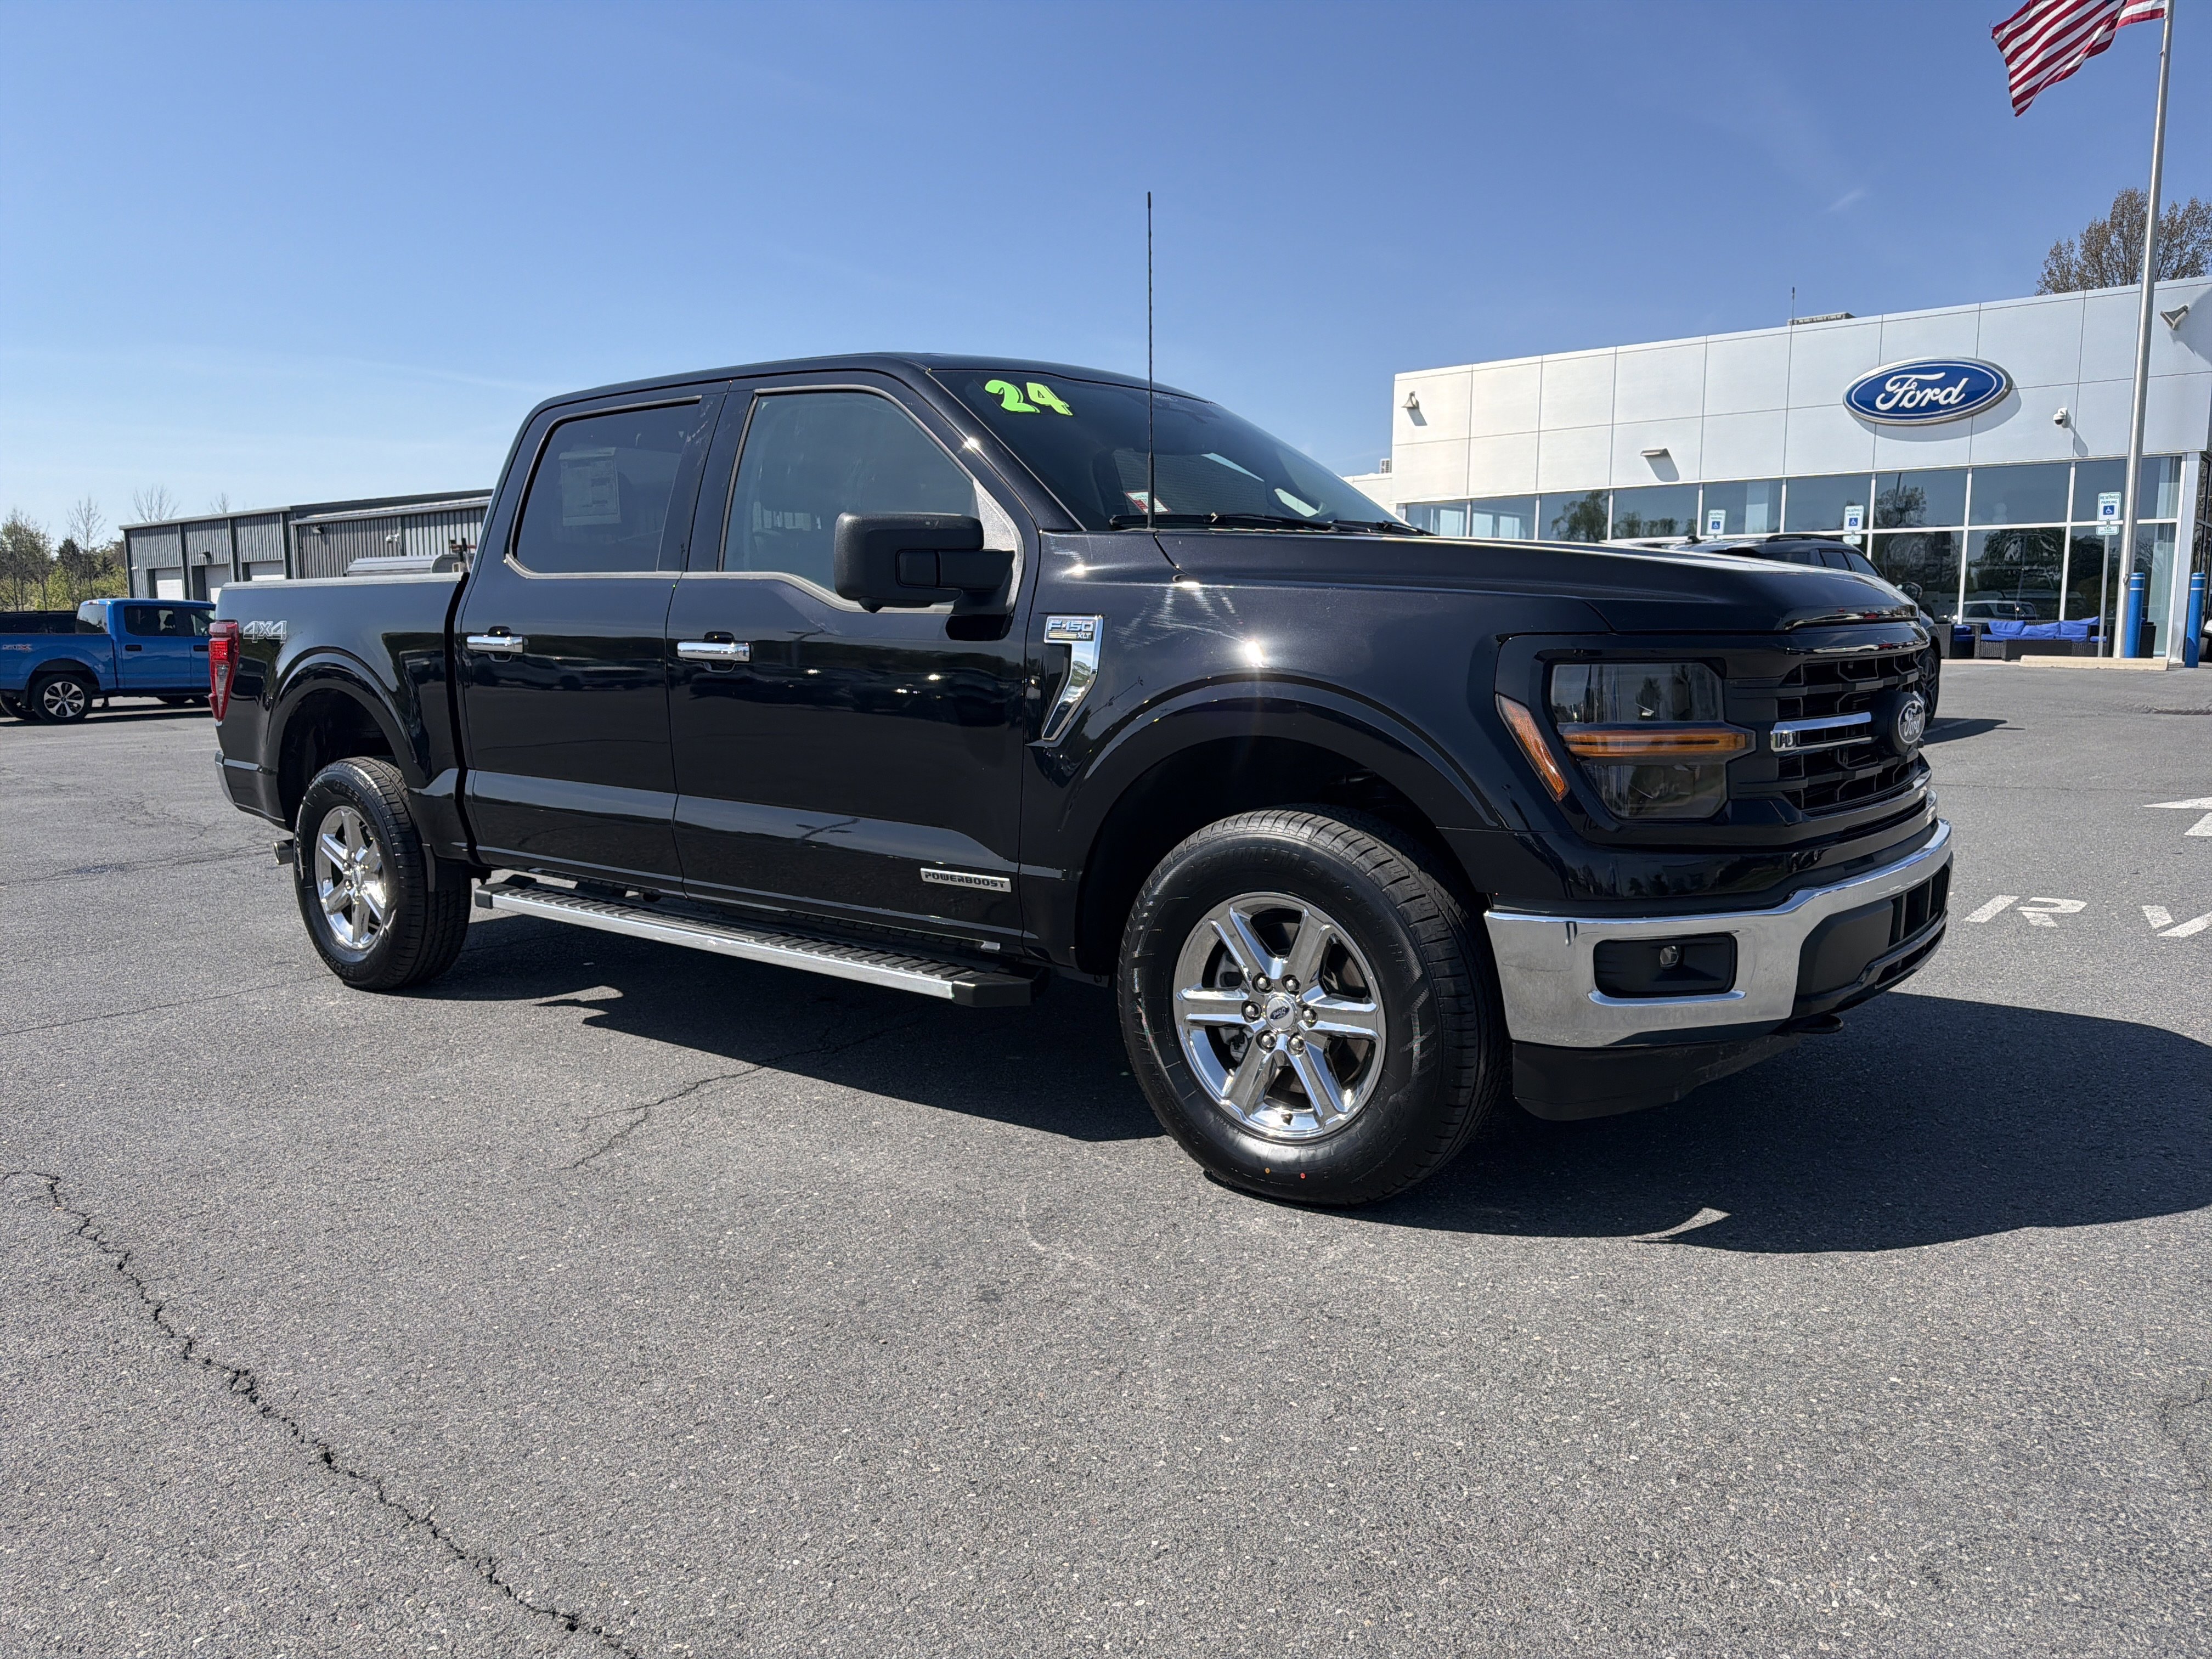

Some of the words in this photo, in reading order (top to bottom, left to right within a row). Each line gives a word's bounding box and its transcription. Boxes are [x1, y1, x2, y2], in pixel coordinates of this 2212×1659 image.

[985, 380, 1073, 416] 24
[1876, 372, 1969, 410] Ford
[1048, 619, 1093, 631] F-150
[1904, 705, 1921, 737] Ford
[924, 872, 1006, 888] POWERBOOST
